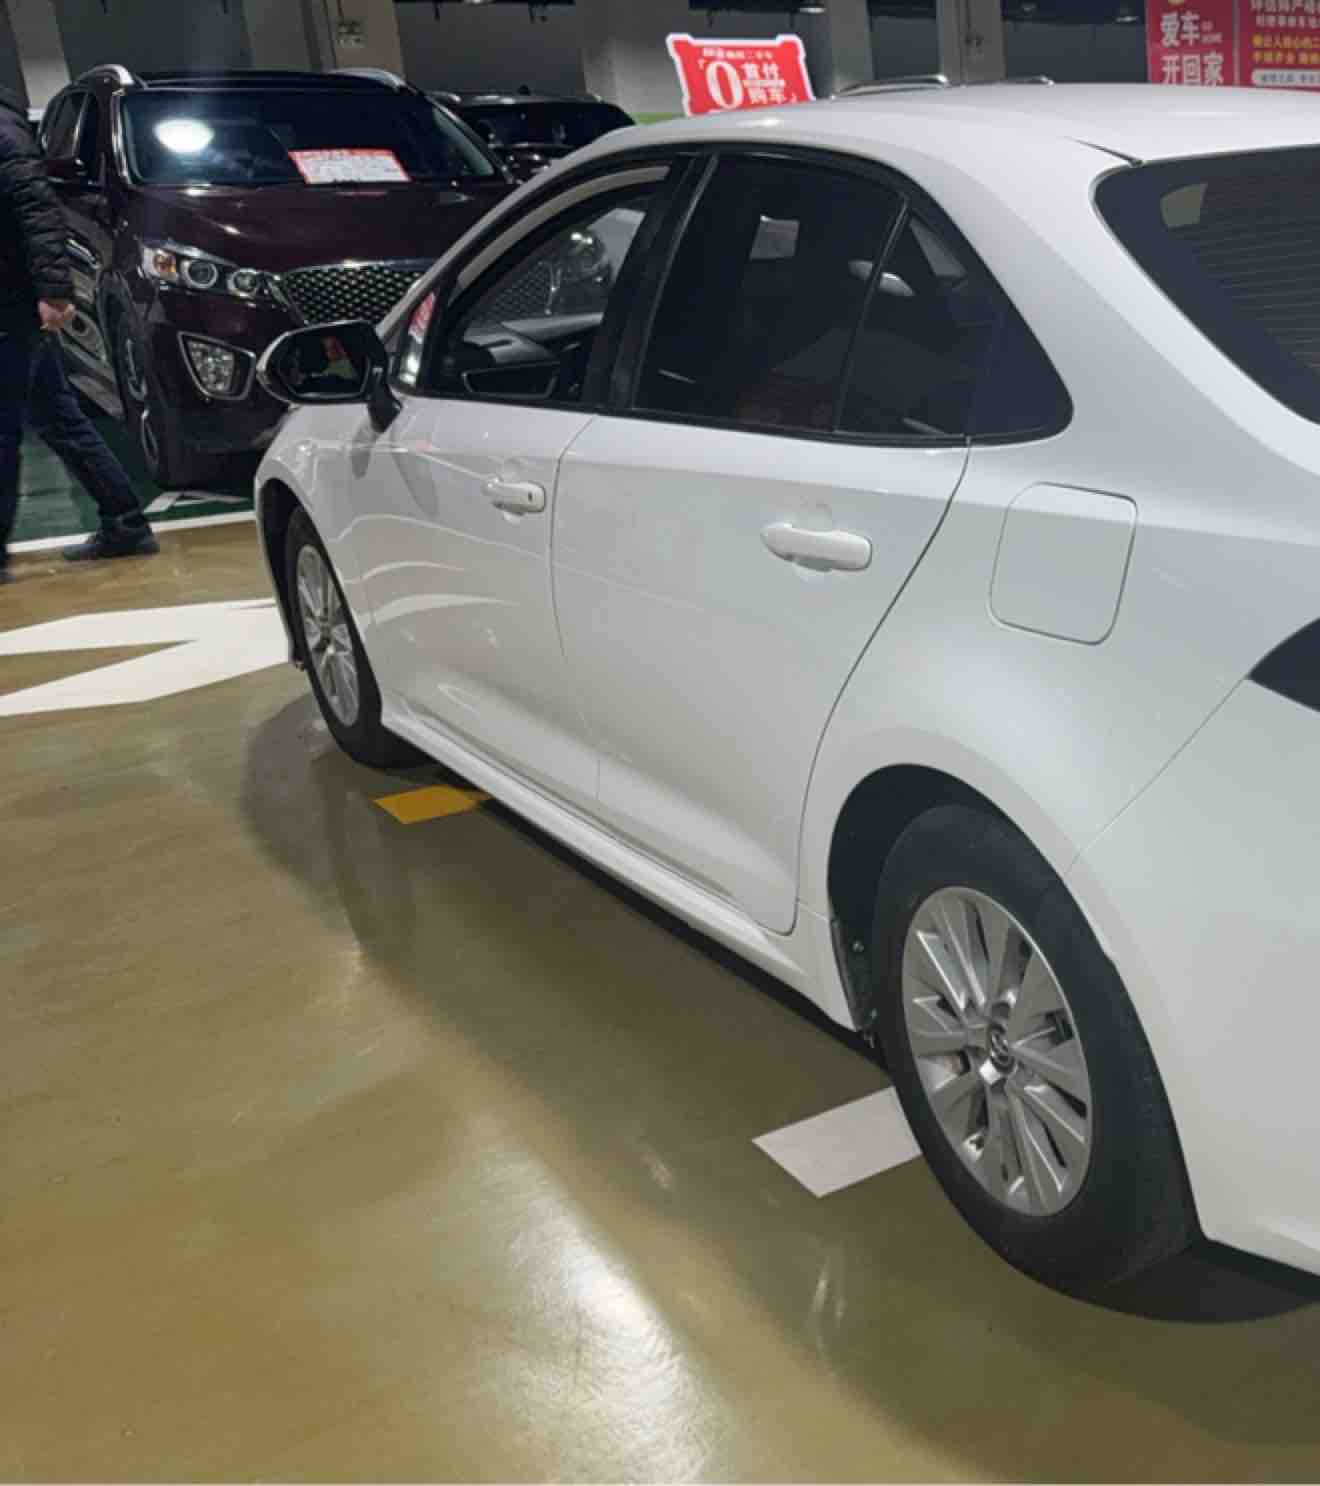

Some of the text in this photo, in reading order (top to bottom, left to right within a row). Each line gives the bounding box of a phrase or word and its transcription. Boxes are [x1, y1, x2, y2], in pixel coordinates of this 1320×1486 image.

[1160, 11, 1200, 48] 爱车
[1161, 52, 1225, 87] 开回家
